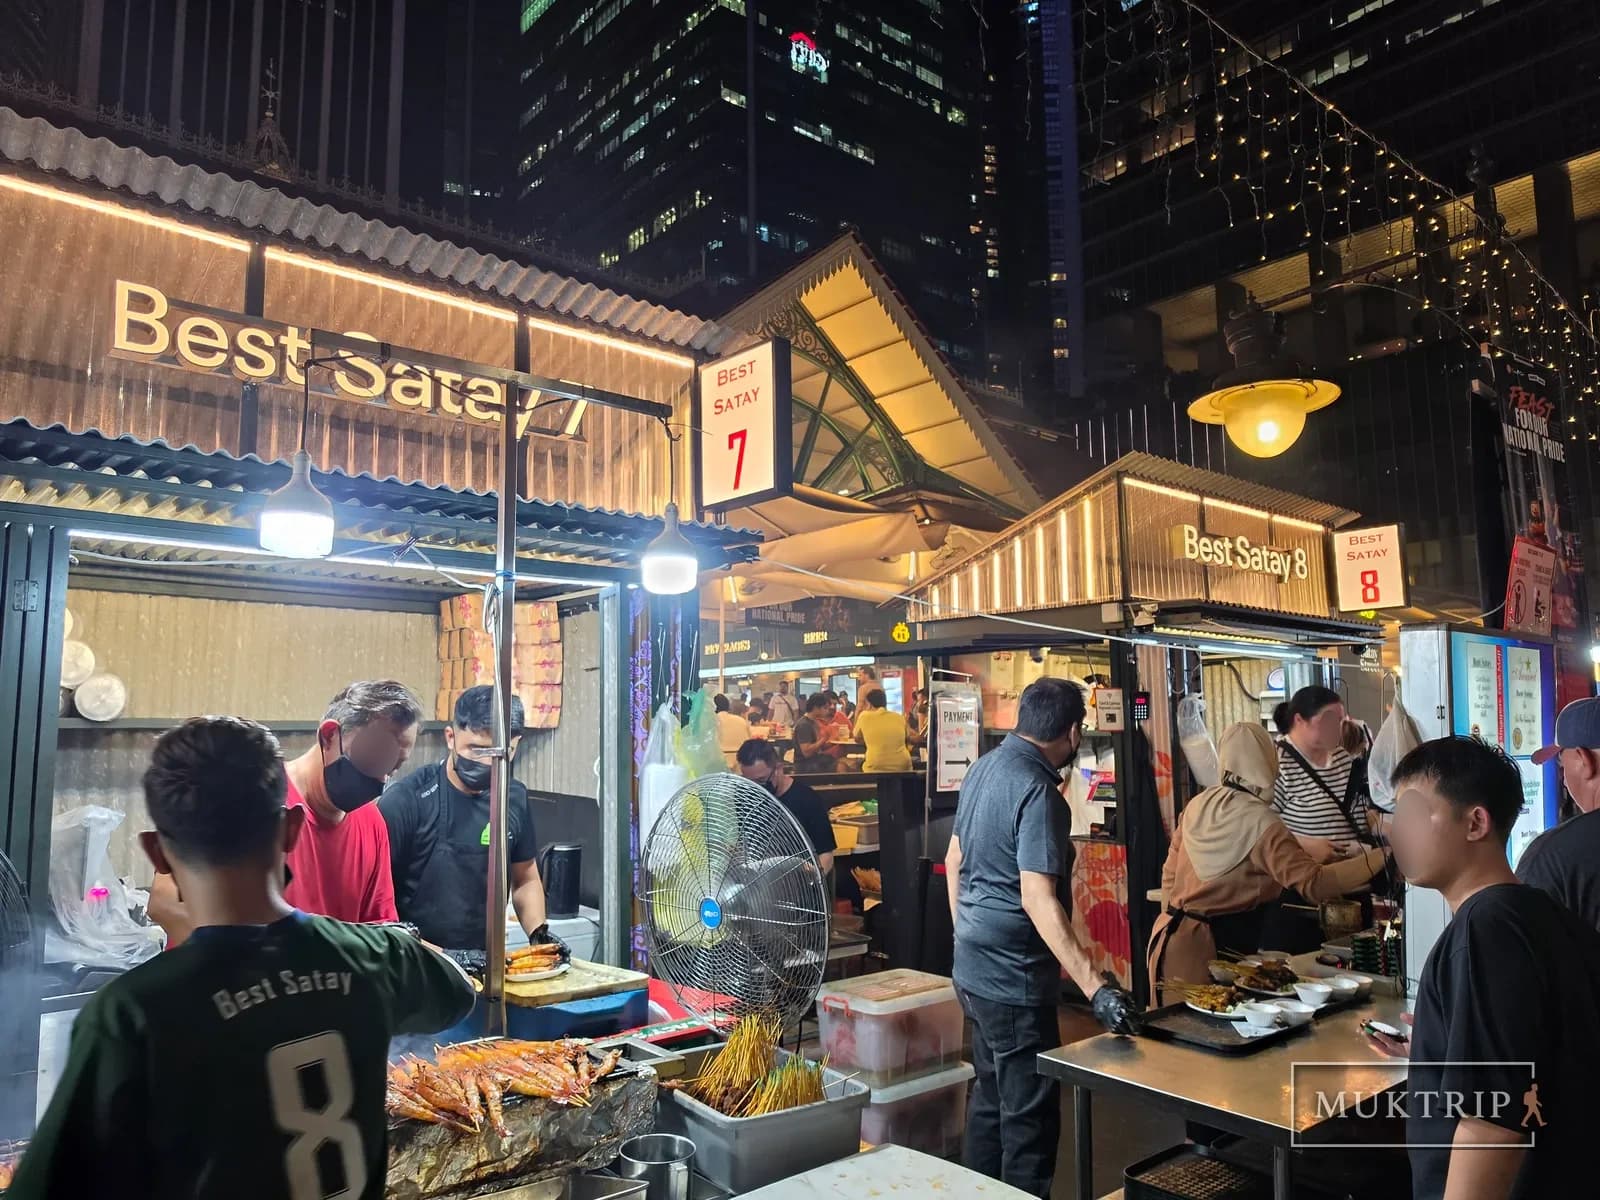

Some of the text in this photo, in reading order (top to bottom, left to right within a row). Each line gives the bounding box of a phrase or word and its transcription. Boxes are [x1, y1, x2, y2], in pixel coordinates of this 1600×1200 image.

[113, 279, 312, 386] Best
[716, 359, 757, 387] BEST
[713, 387, 761, 415] SATAY
[728, 428, 748, 490] 7
[1541, 437, 1566, 464] PRIDE
[1183, 524, 1308, 583] Best Satay 8
[1346, 548, 1388, 561] SATAY
[1348, 534, 1383, 546] BEST
[1361, 570, 1380, 603] 8
[943, 711, 974, 723] PAYMENT
[212, 970, 352, 1020] Best Satay
[266, 1029, 368, 1200] 8
